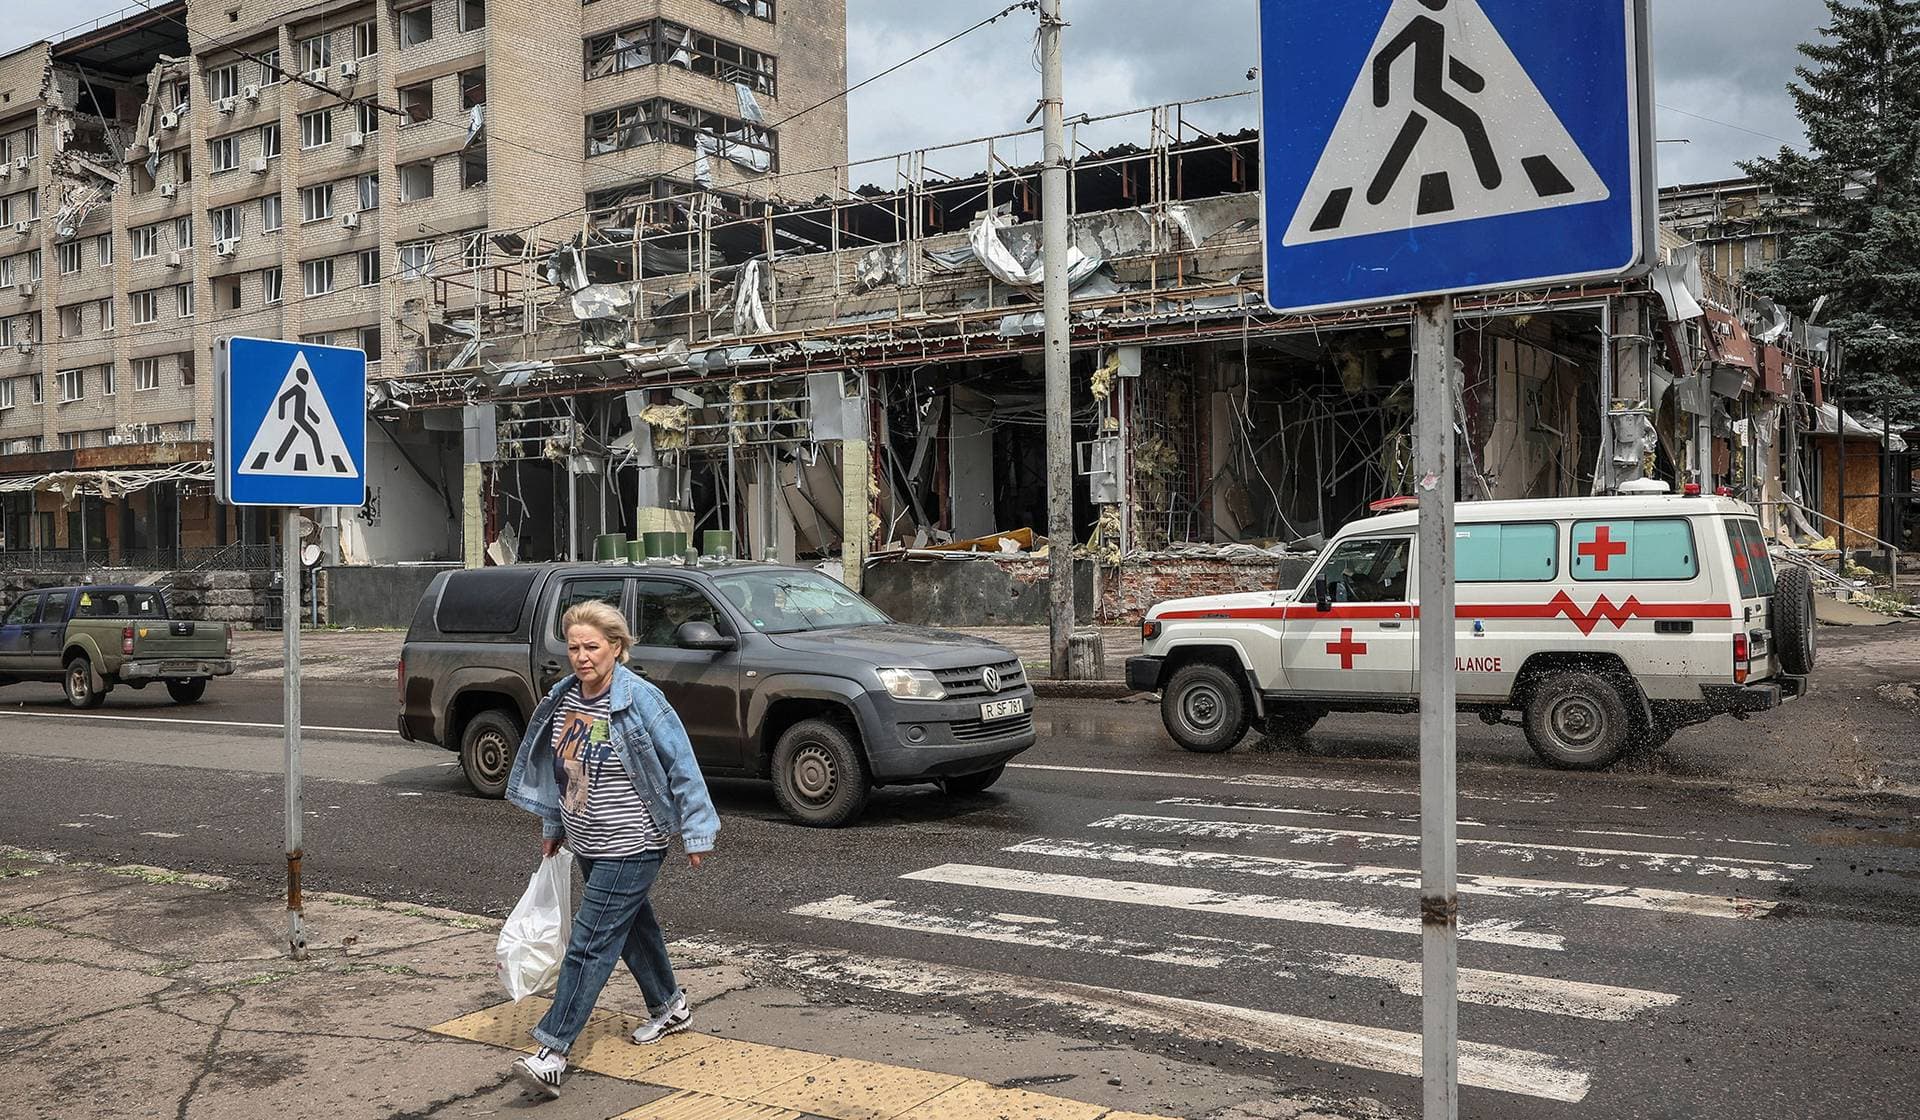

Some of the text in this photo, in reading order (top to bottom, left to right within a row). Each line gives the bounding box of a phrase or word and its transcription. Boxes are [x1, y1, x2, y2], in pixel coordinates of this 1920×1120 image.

[986, 700, 1022, 718] R SF 781
